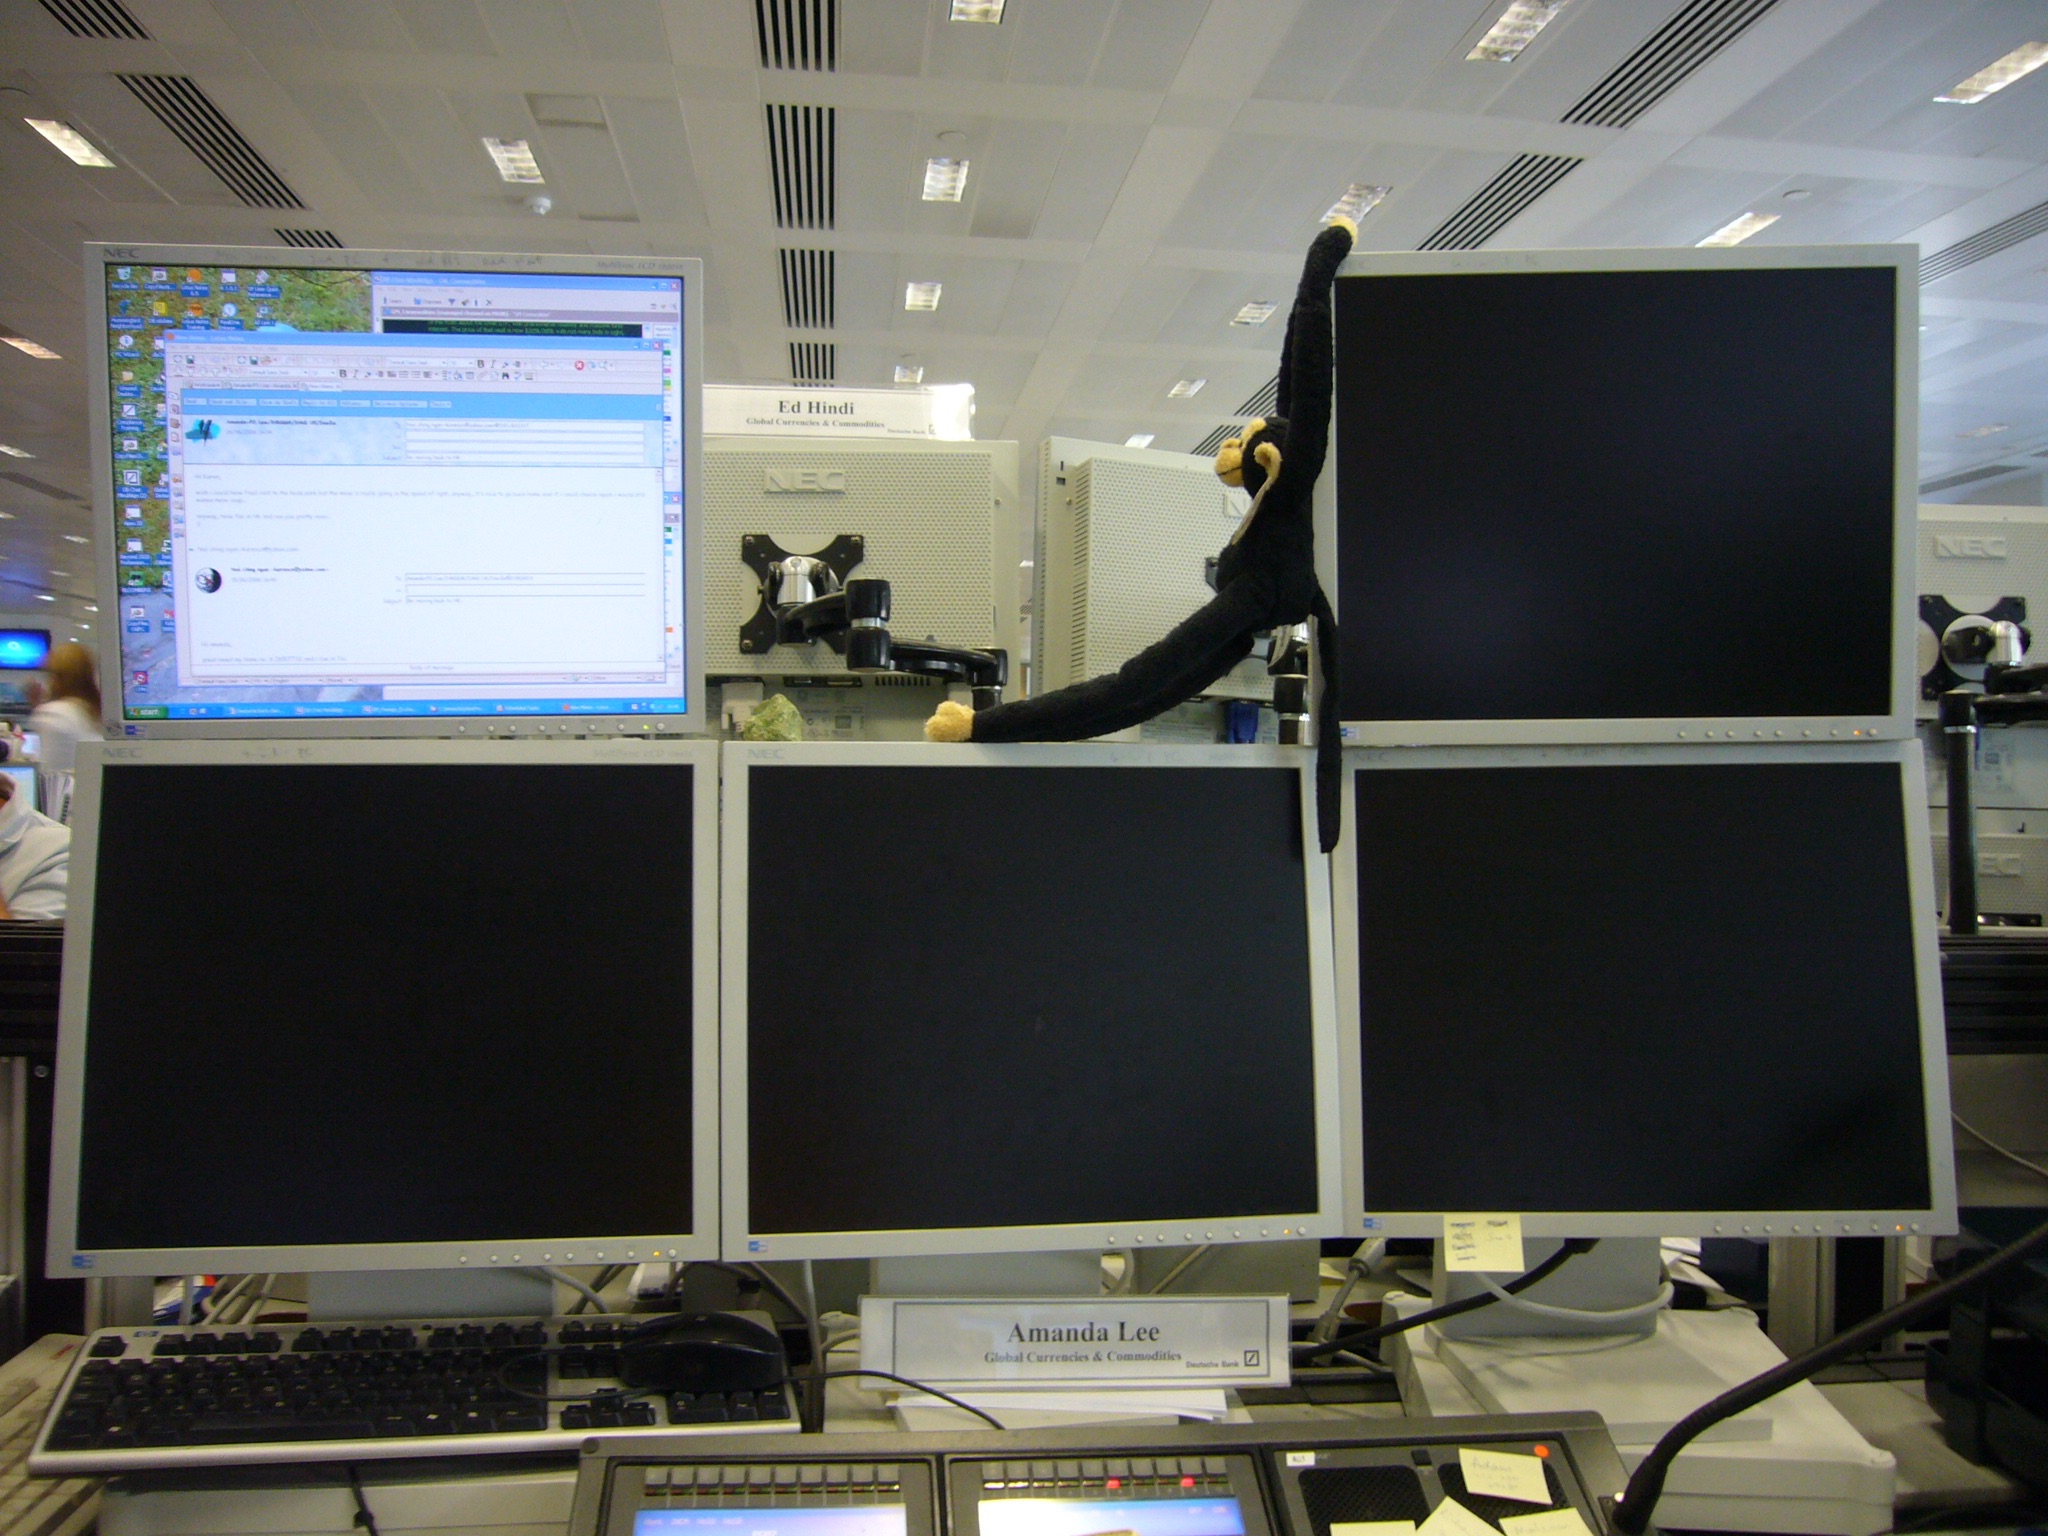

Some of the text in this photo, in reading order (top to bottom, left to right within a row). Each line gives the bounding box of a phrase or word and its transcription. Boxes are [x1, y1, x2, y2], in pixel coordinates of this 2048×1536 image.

[104, 248, 140, 260] NEC
[778, 400, 854, 415] Ed Hindi
[746, 417, 774, 426] Global
[776, 419, 820, 427] Currencies
[832, 420, 885, 428] Commodities
[764, 469, 845, 494] NEC
[1933, 536, 2007, 560] NEC
[103, 747, 143, 758] NEC
[748, 748, 785, 759] NEC
[1007, 1321, 1160, 1342] Amanda Lee
[984, 1349, 1181, 1363] Global Currencies & Commodities
